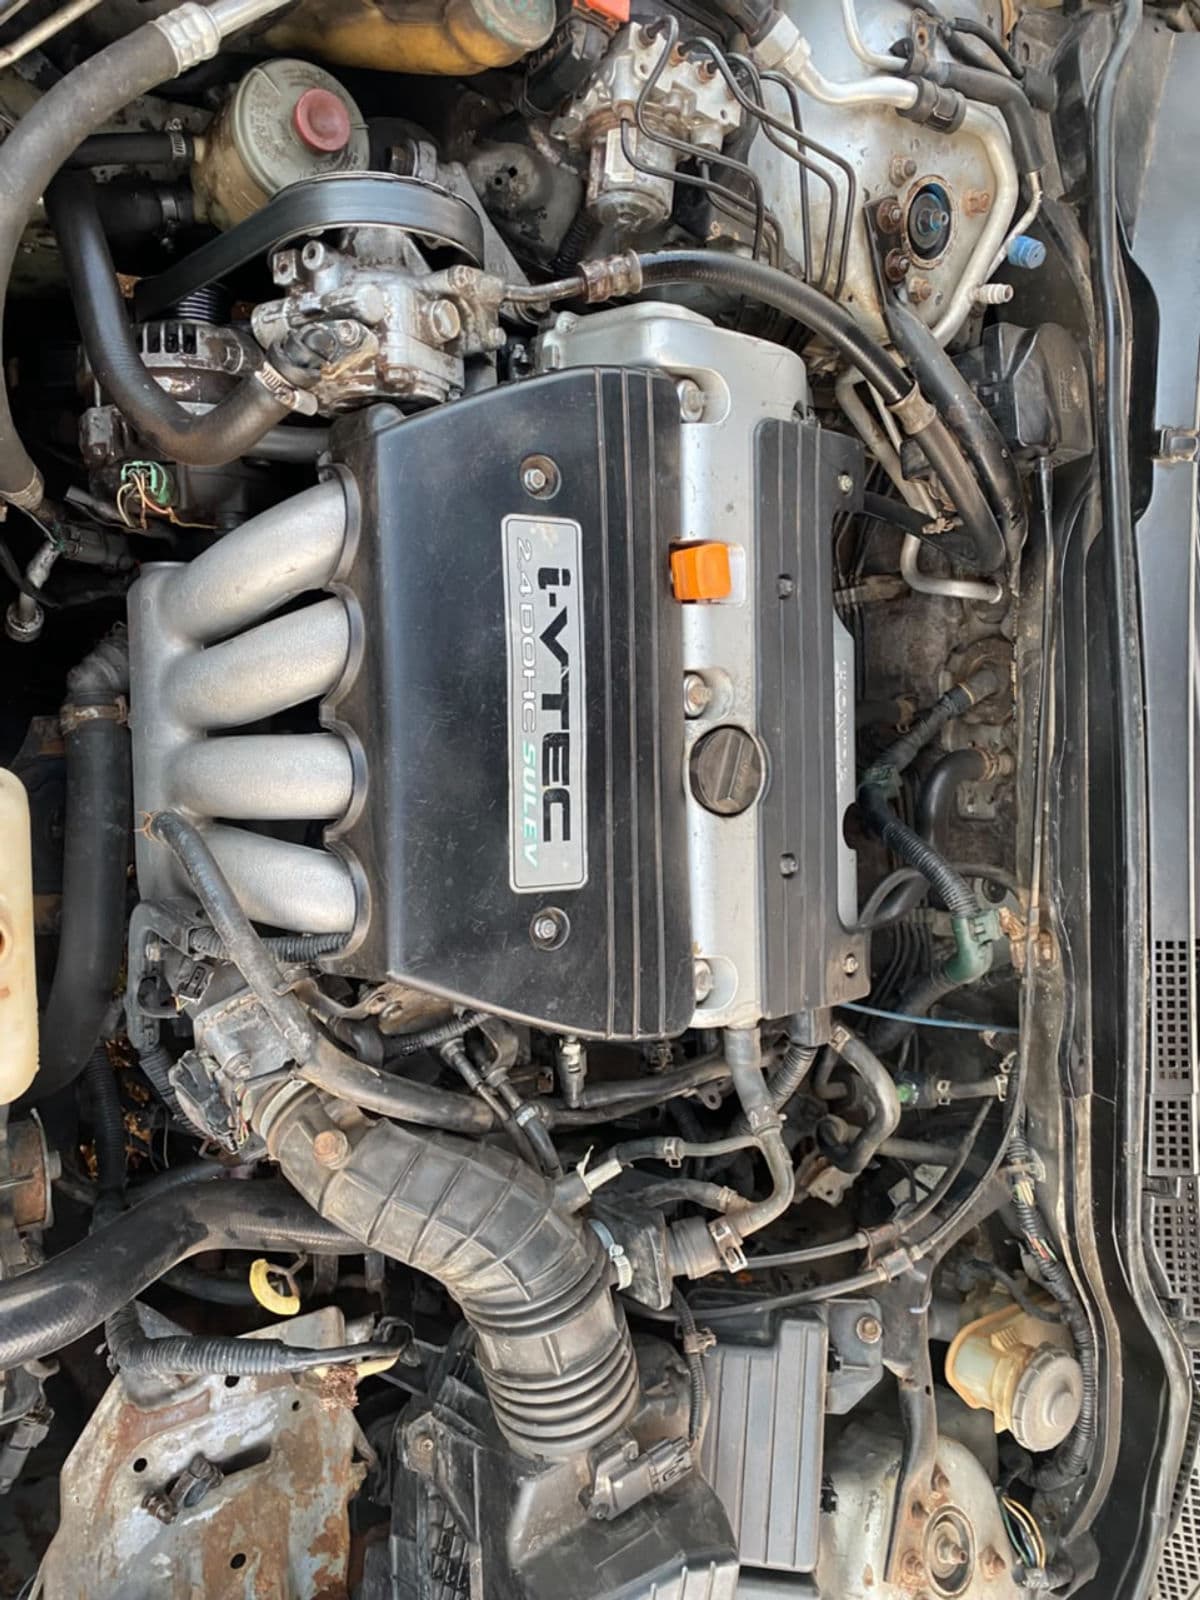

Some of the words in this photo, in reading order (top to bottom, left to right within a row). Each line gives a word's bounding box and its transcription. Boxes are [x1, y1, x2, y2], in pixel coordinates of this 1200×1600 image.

[516, 537, 533, 597] 2.4
[519, 602, 537, 733] DOHC
[537, 566, 572, 843] i-VTEC
[522, 740, 538, 868] SULEV
